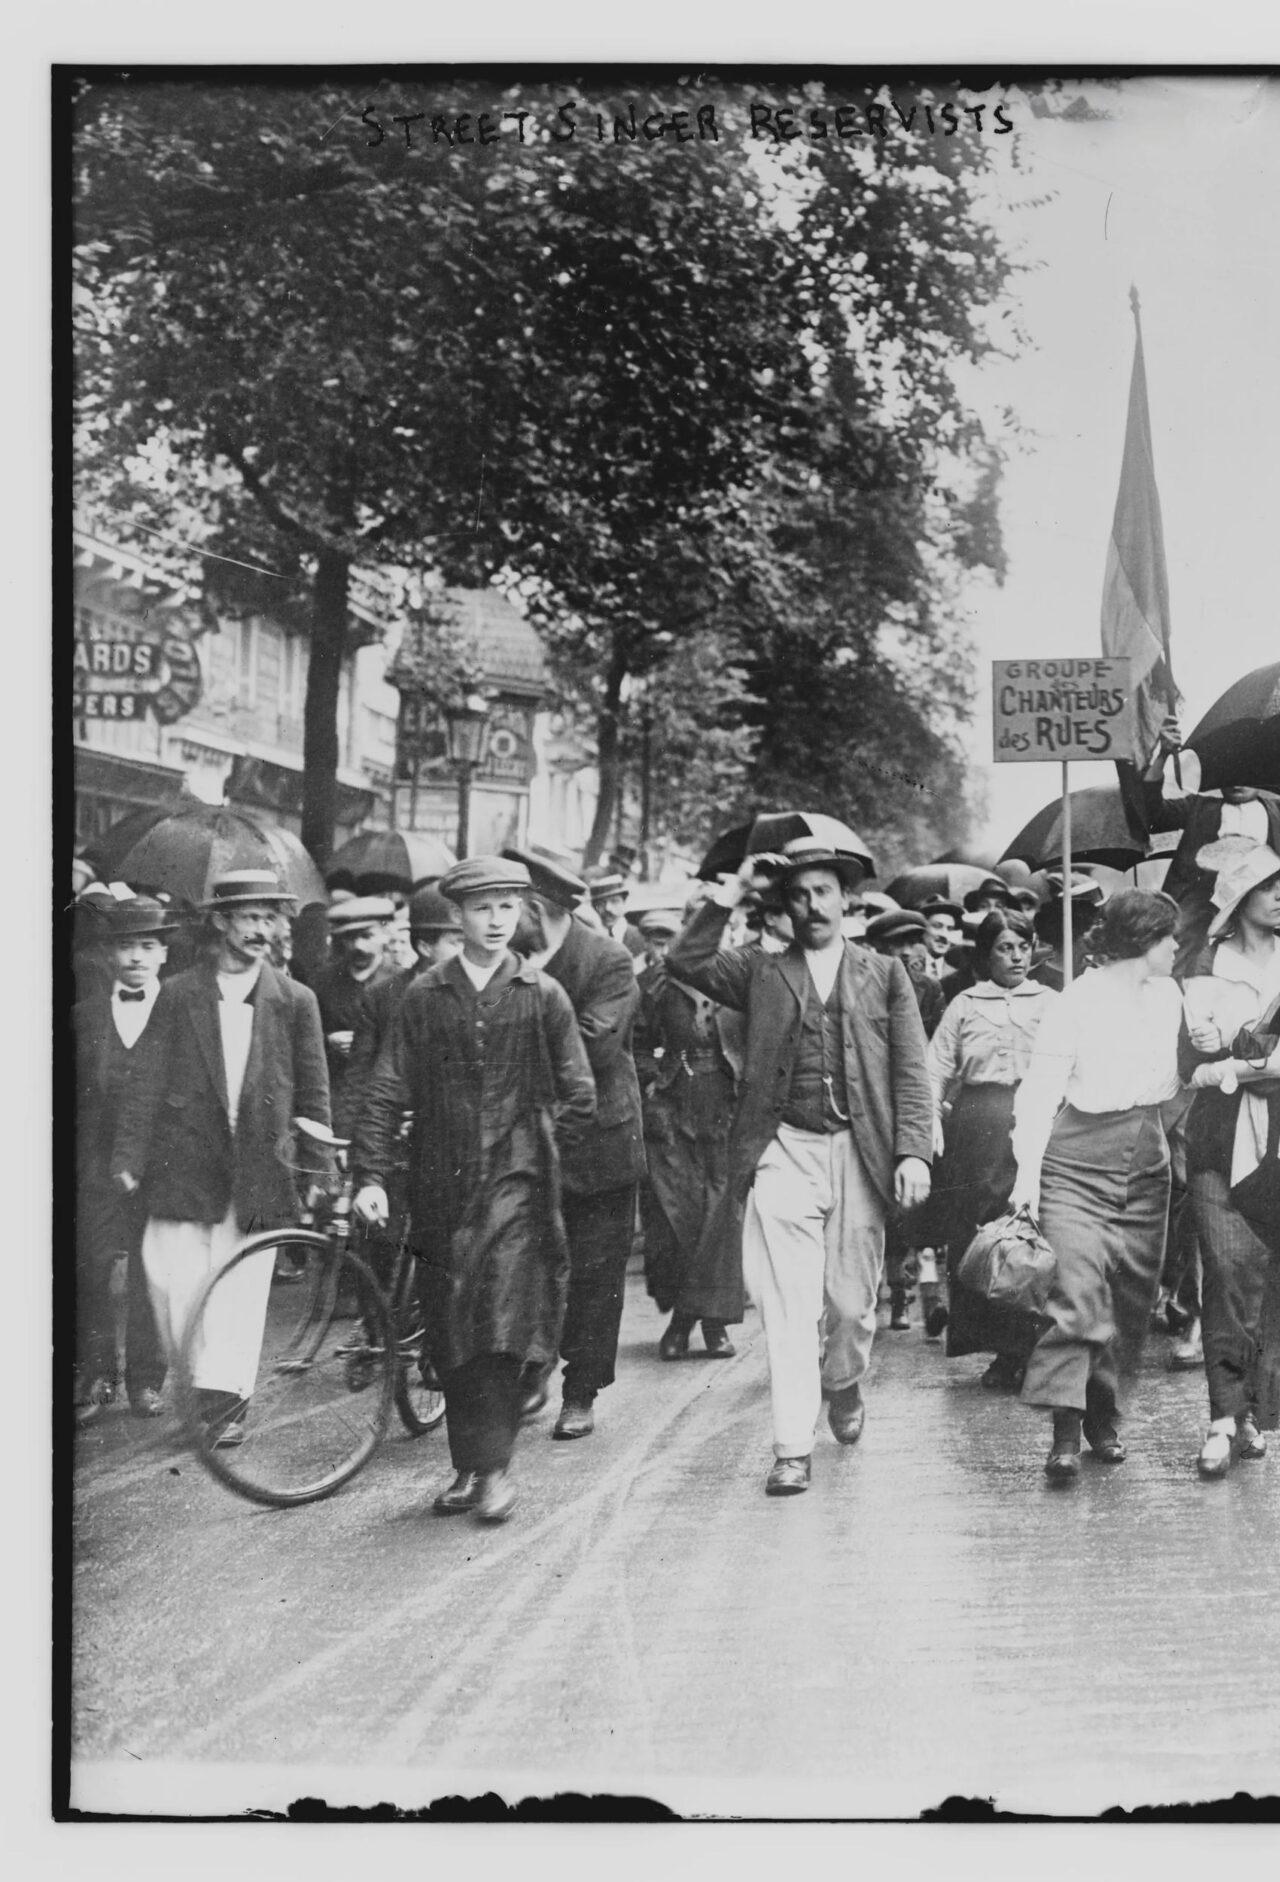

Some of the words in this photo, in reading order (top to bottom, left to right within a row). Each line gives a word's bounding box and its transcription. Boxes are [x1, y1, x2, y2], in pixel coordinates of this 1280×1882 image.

[1005, 660, 1114, 680] GROUPE
[999, 727, 1031, 752] des
[1035, 715, 1112, 754] RUES
